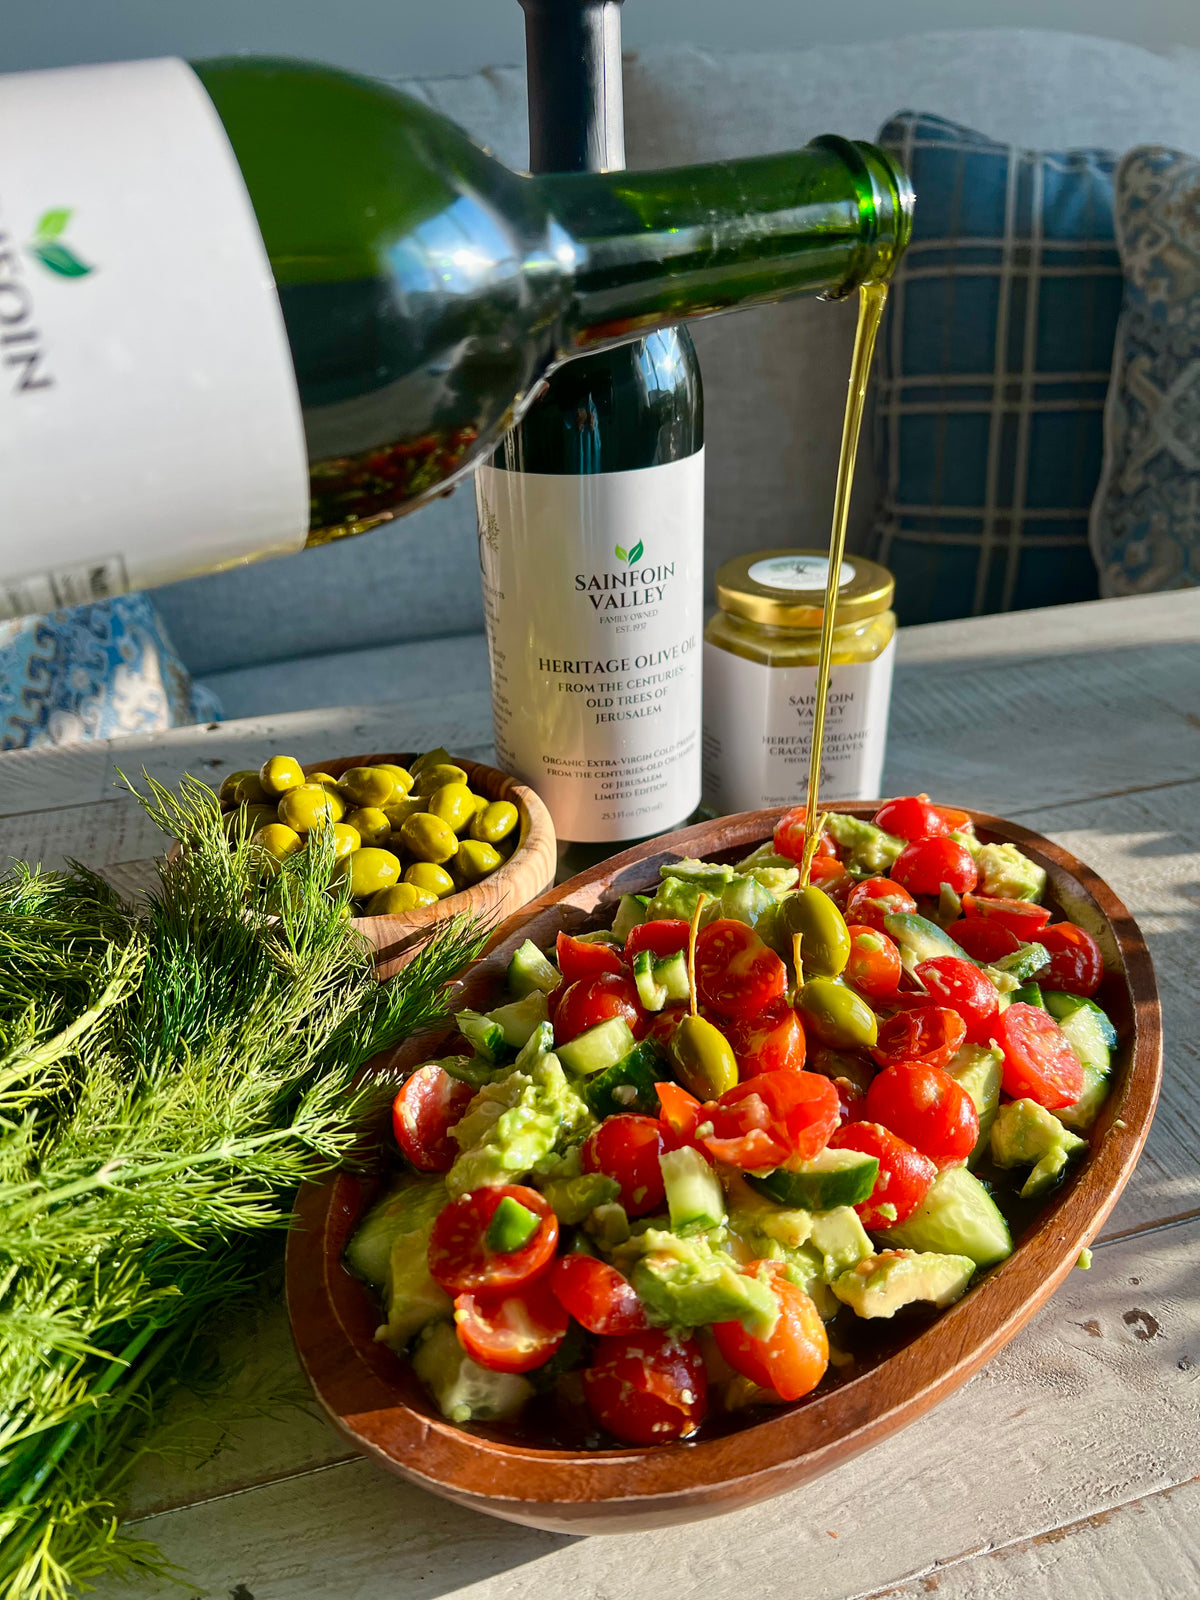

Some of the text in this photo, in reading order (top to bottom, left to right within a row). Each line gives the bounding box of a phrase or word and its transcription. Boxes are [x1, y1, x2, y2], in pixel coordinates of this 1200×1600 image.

[575, 562, 675, 592] SAINFOIN
[588, 584, 667, 610] VALLEY
[599, 609, 658, 624] FAMILY OWNED
[538, 636, 697, 675] HERITAGE OLIVE OIL
[558, 666, 686, 694] FROM THE CENTURIES-
[586, 687, 669, 709] OLD TREES OF
[788, 693, 854, 706] SAINOIN
[595, 704, 662, 725] JERUSALEM
[796, 705, 846, 717] VAEY
[762, 735, 813, 745] HERITAG
[769, 742, 864, 756] CRACK OLIVES
[542, 755, 585, 767] ORGANIC
[587, 753, 652, 767] EXTRA-VIRGIN
[547, 768, 572, 778] FROM
[574, 770, 593, 779] THE
[594, 760, 663, 779] CENTURIES-OLD
[594, 782, 668, 801] LIMITED EDITION
[601, 774, 662, 790] OF JERUSALEM
